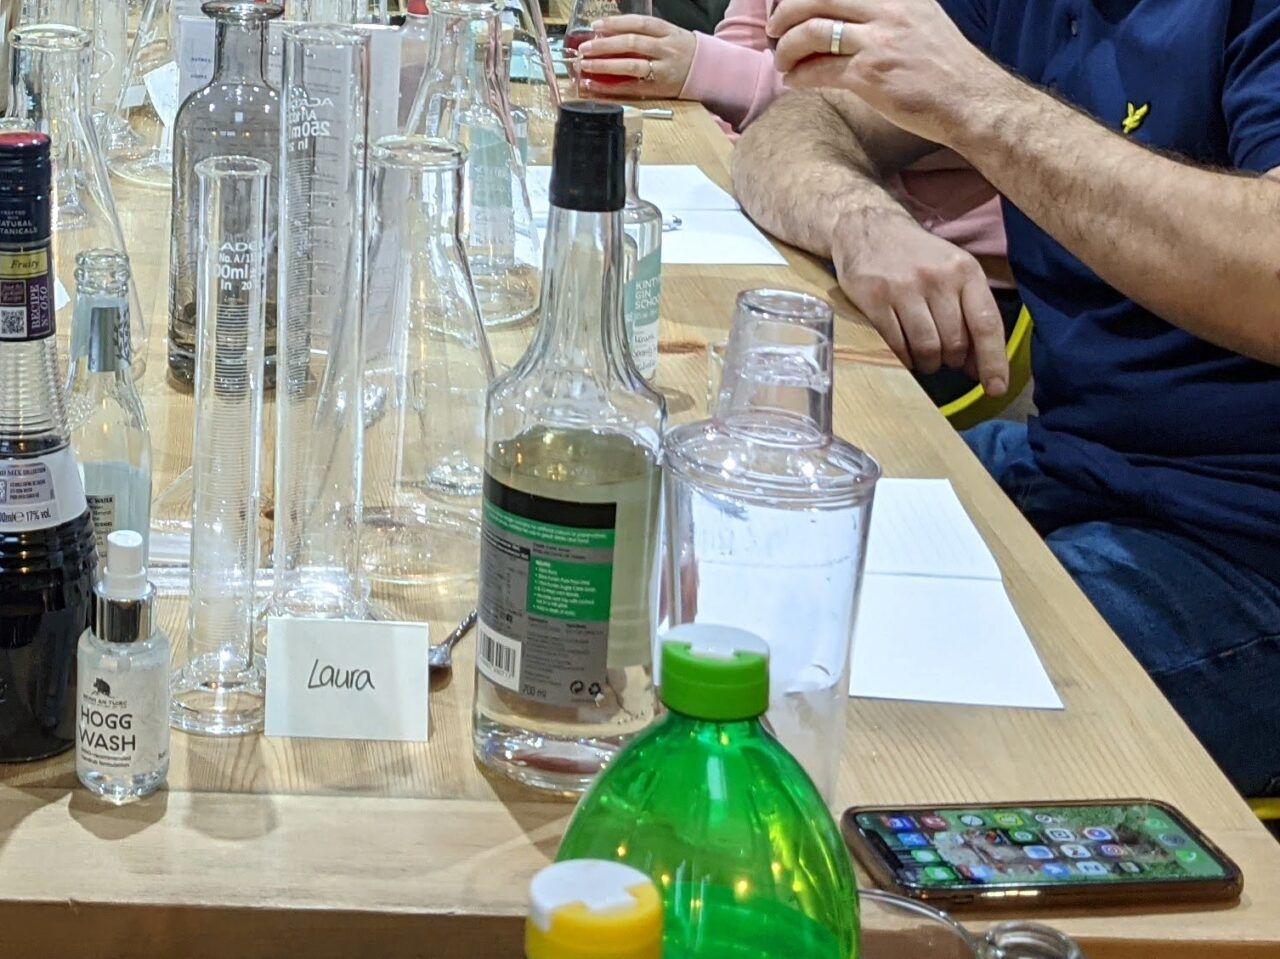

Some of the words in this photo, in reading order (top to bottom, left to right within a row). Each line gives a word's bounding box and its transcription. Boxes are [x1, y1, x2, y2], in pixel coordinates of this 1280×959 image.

[10, 259, 40, 271] Fruity
[30, 283, 41, 330] RECIPE
[26, 510, 40, 522] 17%
[307, 658, 376, 691] Laura
[80, 704, 133, 730] HOGG
[78, 724, 136, 752] WASH
